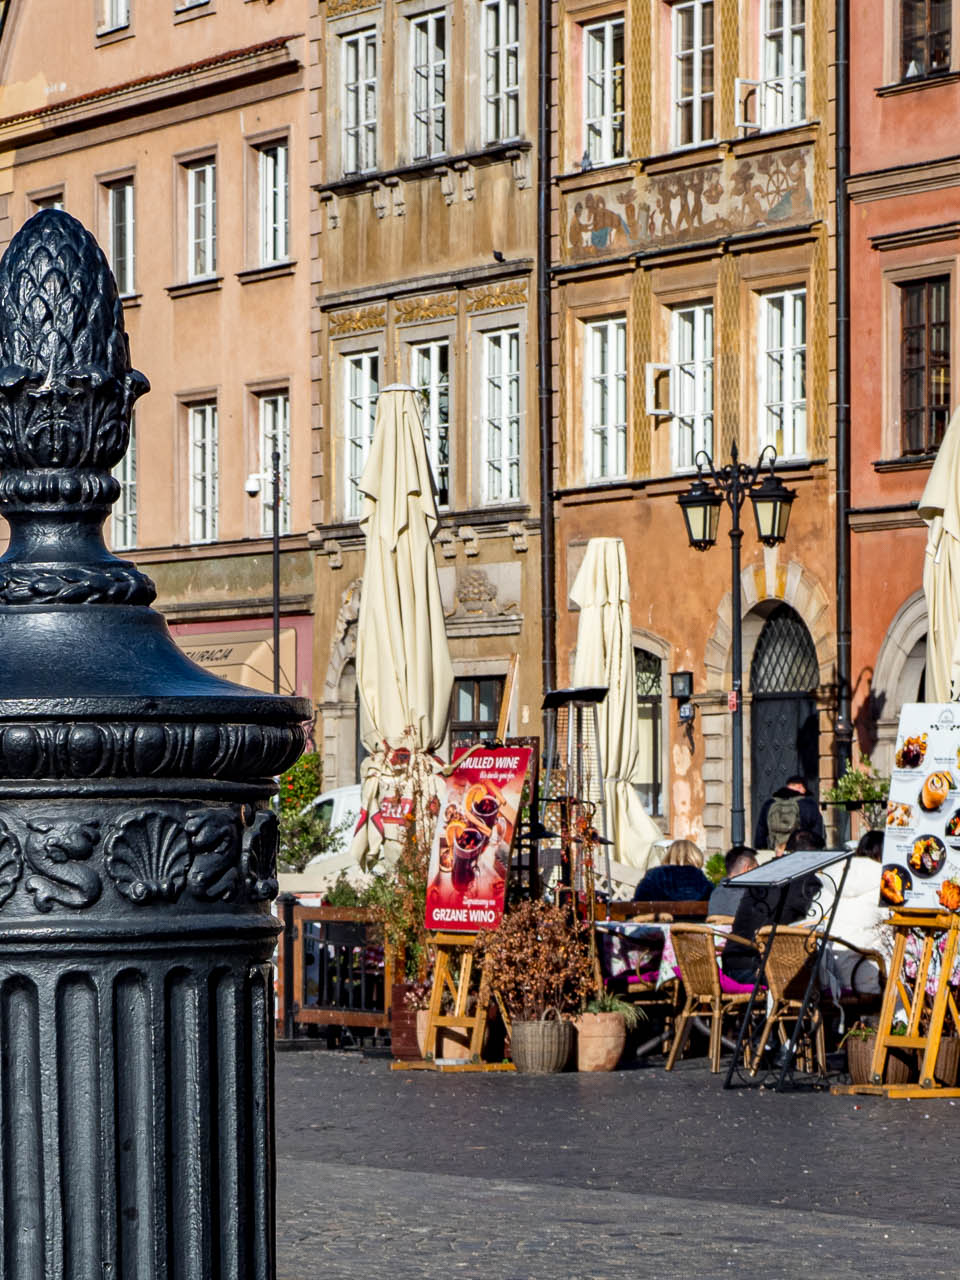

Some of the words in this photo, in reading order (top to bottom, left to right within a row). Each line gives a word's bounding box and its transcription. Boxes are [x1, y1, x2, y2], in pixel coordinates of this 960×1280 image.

[460, 756, 494, 769] MULLED
[495, 757, 520, 769] WINE
[432, 908, 468, 922] GRZANE
[469, 909, 496, 923] WINO
